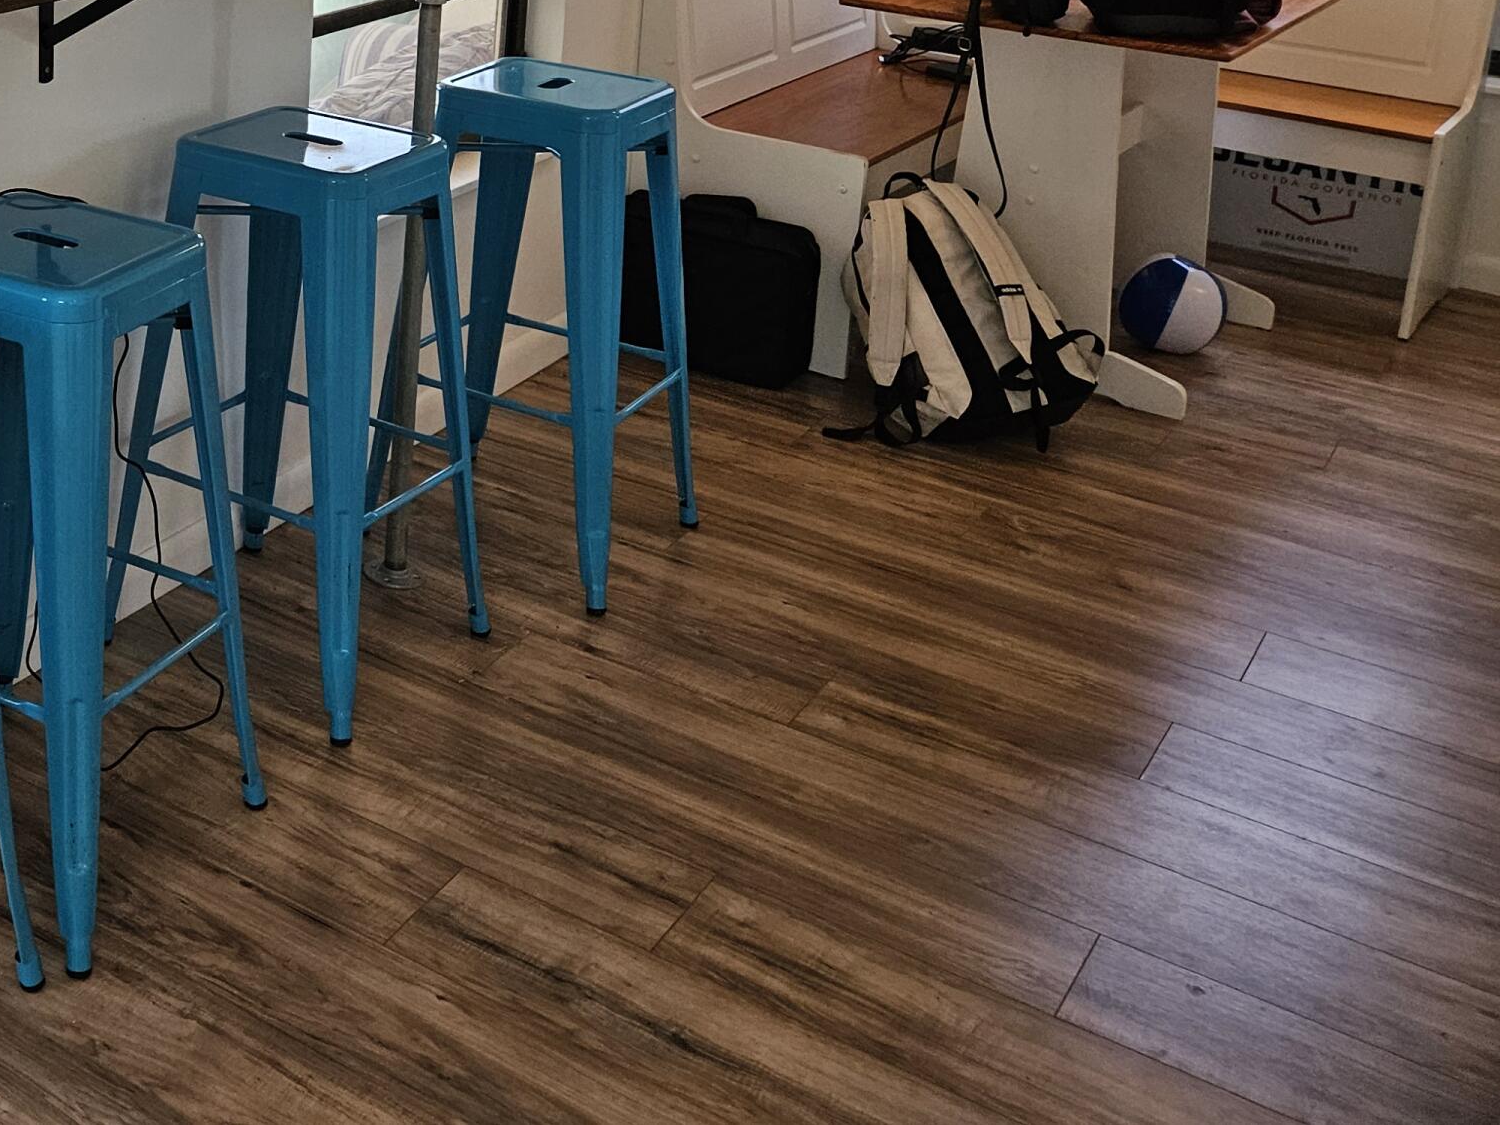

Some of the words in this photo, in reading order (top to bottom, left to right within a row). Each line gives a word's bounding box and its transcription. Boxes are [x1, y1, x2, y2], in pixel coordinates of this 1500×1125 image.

[1232, 167, 1300, 187] FLORIDA
[1309, 181, 1404, 205] GOVERNOR
[1285, 233, 1329, 246] FLORIDA
